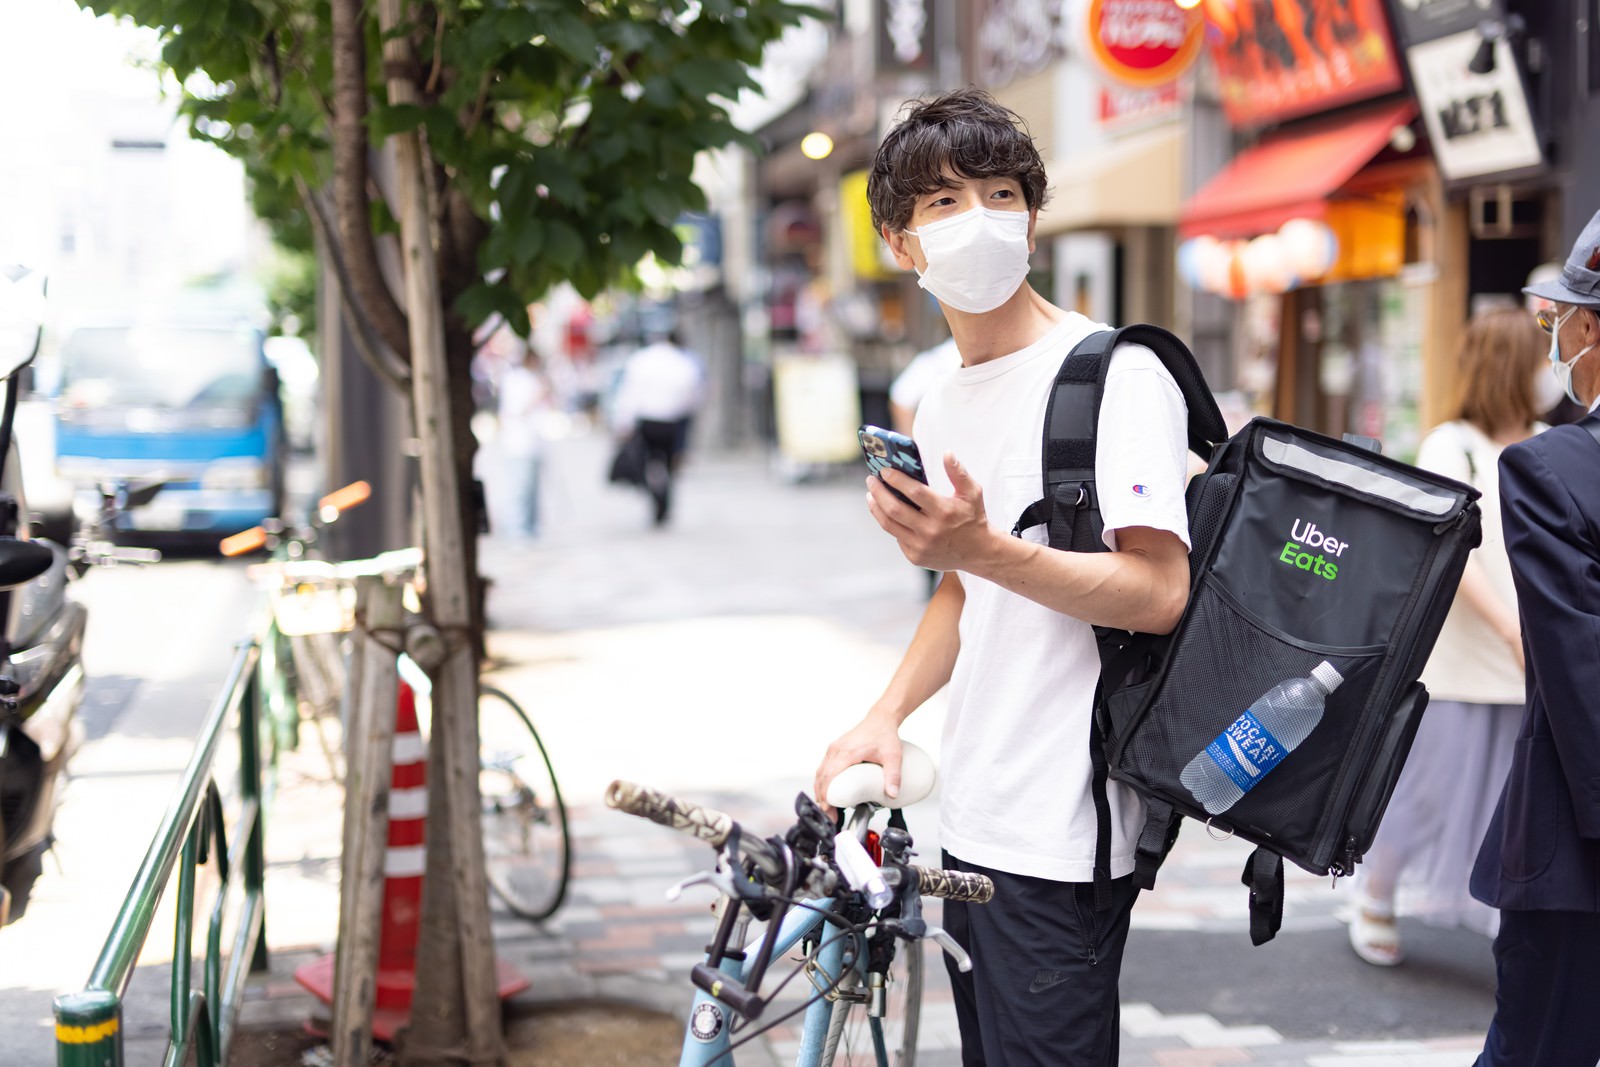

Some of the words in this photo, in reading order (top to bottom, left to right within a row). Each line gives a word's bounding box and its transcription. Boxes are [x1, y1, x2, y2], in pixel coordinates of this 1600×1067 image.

[1290, 518, 1349, 557] Uber
[1279, 541, 1339, 580] Eats
[1227, 722, 1269, 764] SWEAT
[1236, 714, 1280, 760] POCARI
[1034, 970, 1061, 983] NIKE
